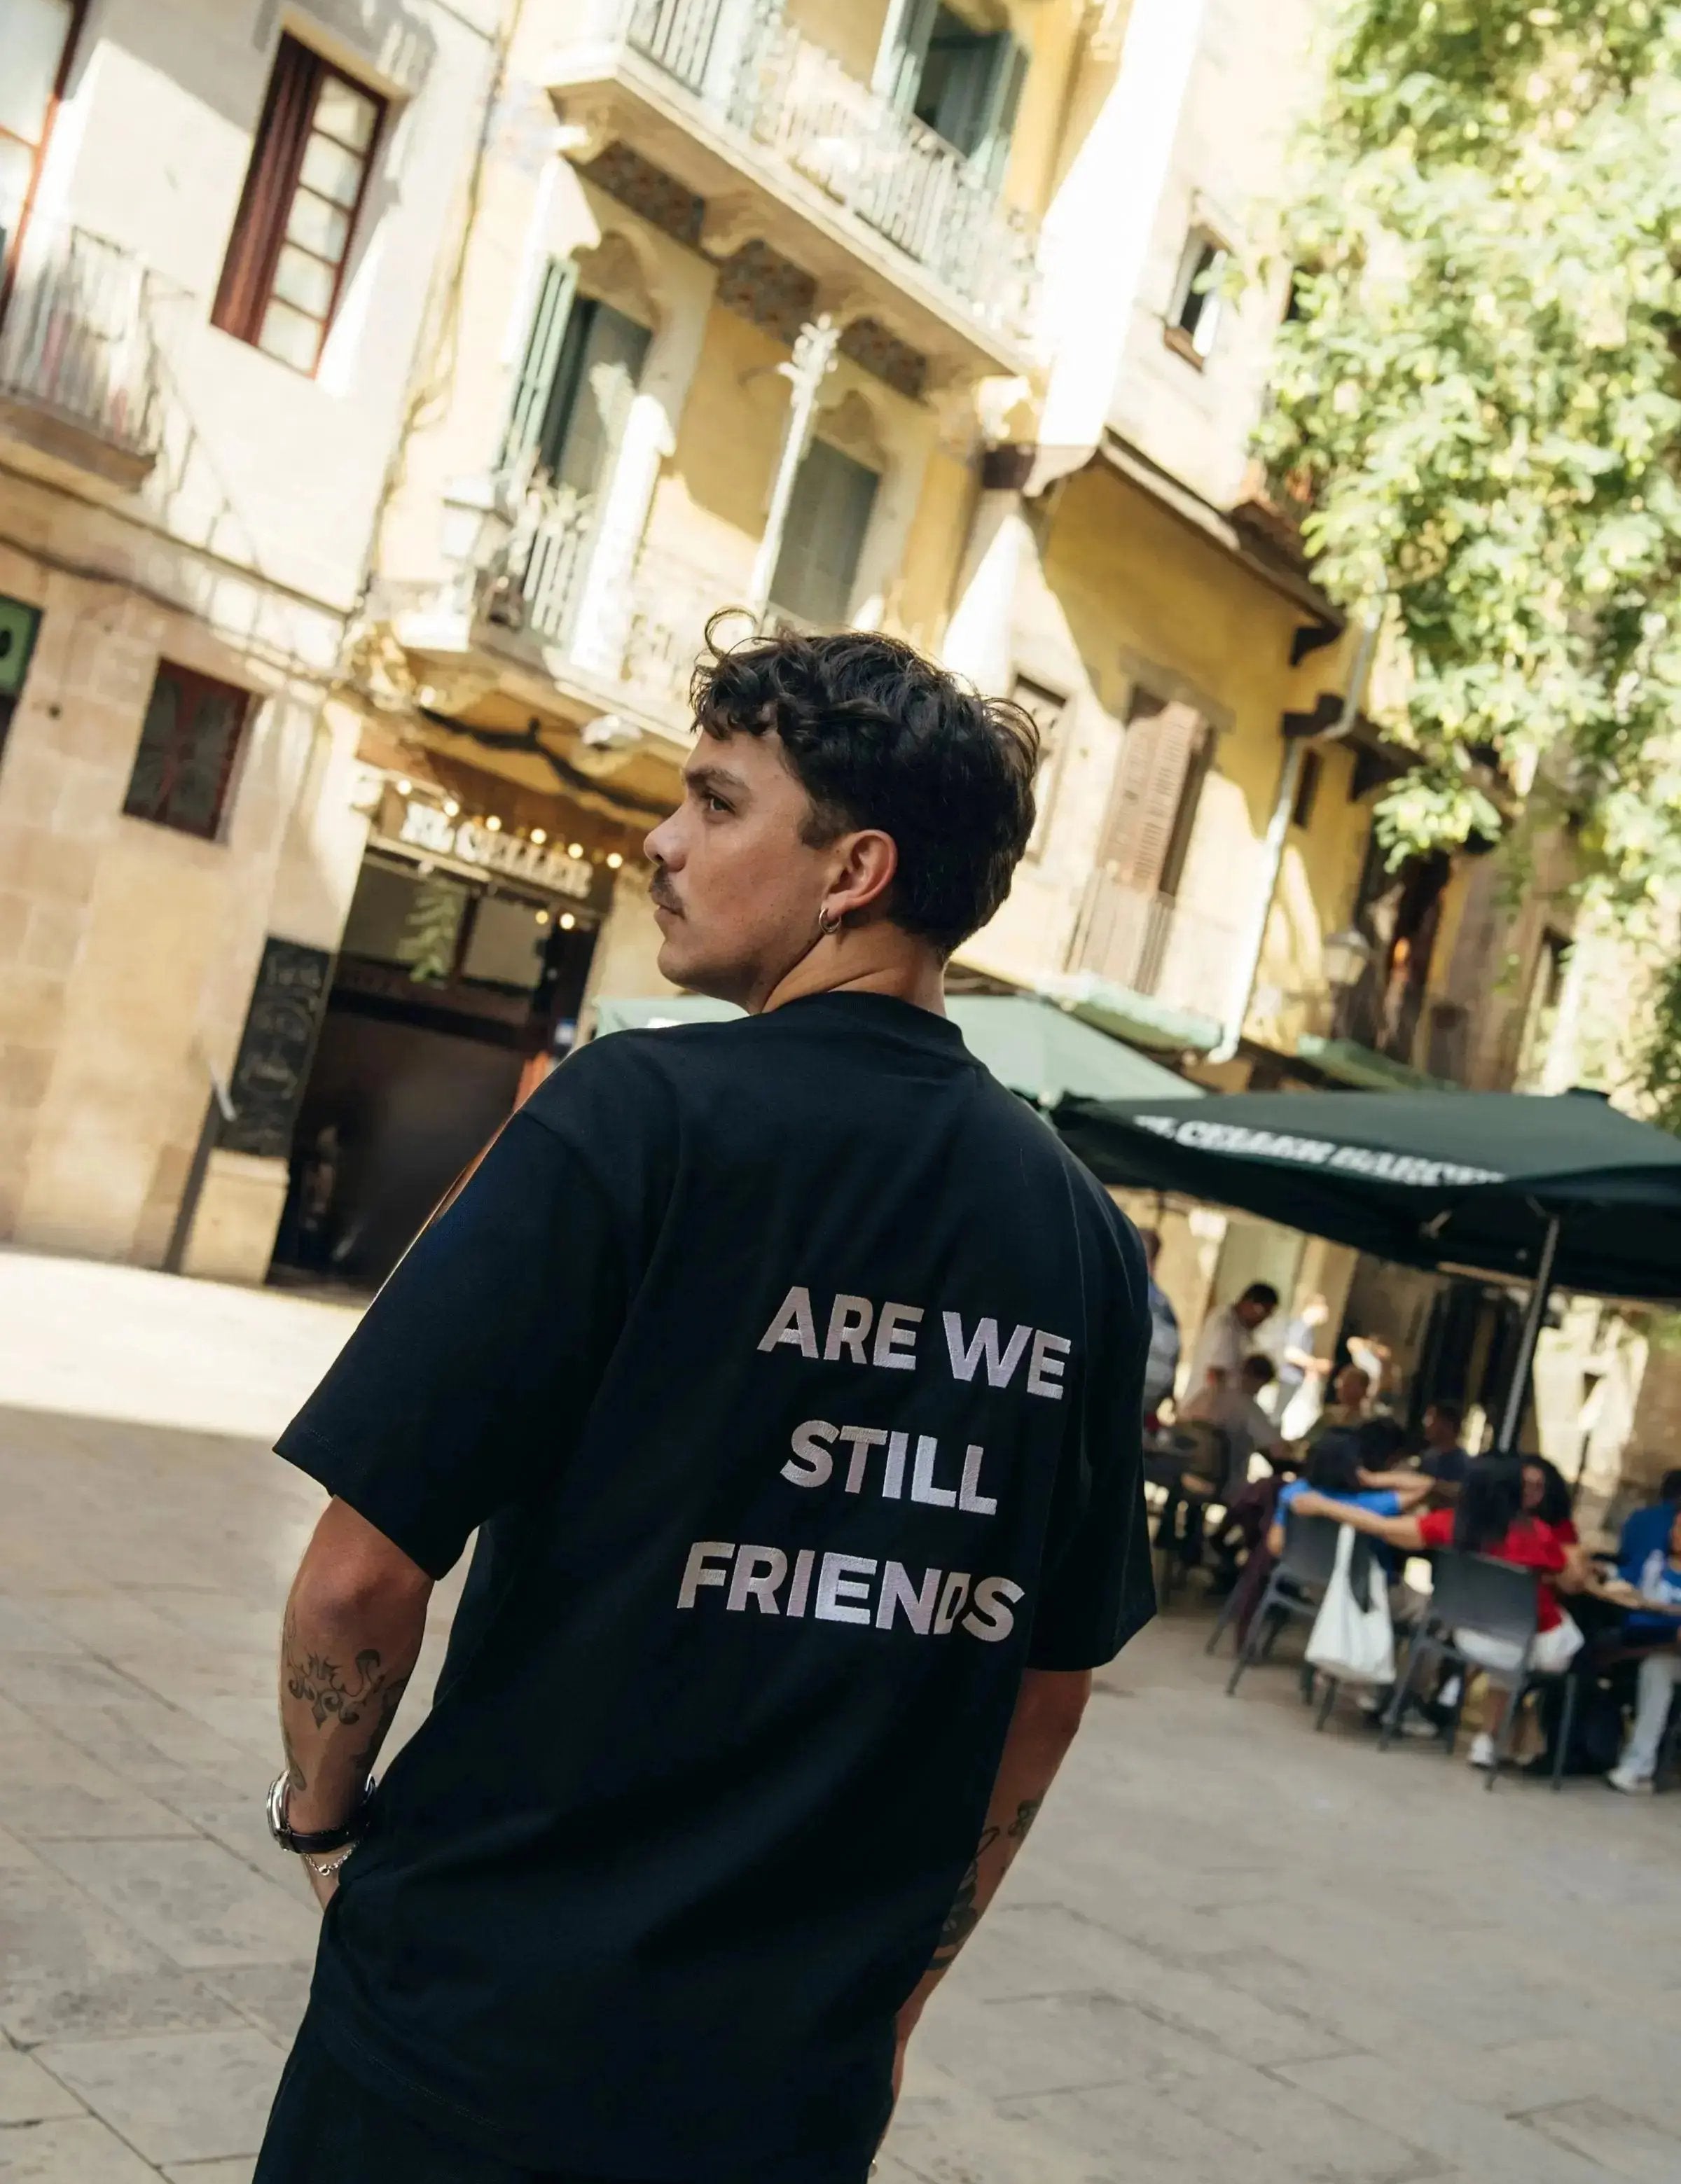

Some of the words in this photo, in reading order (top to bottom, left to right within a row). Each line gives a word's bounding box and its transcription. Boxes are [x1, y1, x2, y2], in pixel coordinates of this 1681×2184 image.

[757, 1286, 924, 1370] ARE
[943, 1312, 1071, 1399] WE
[780, 1420, 997, 1515] STILL
[677, 1542, 1025, 1641] FRIENDS
